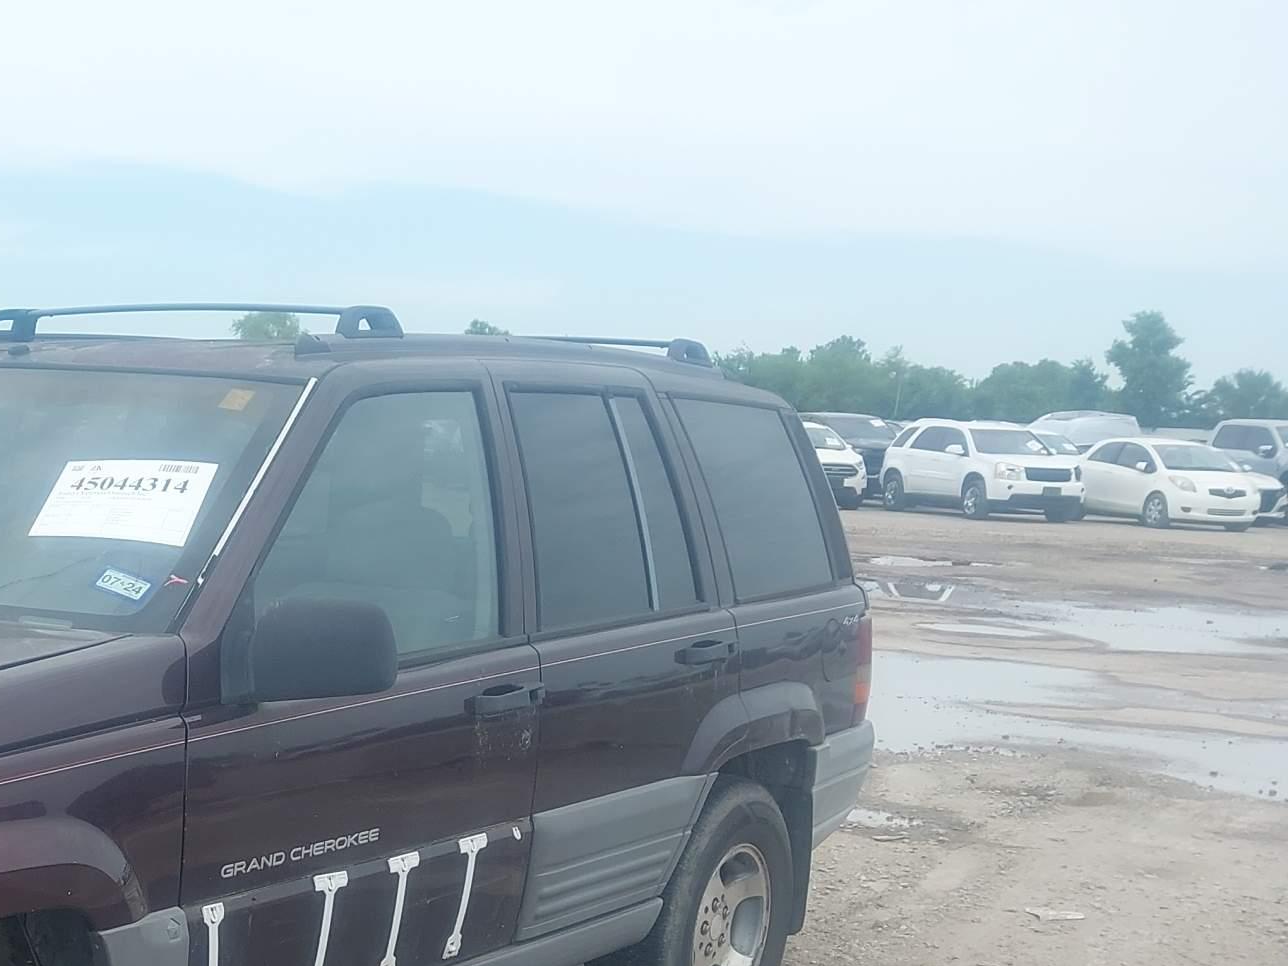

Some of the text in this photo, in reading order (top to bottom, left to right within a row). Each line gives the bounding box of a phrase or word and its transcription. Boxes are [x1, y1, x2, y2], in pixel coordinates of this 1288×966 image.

[70, 476, 190, 494] 45044314
[101, 574, 121, 586] 07
[220, 828, 381, 878] GRAND CHEROKEE
